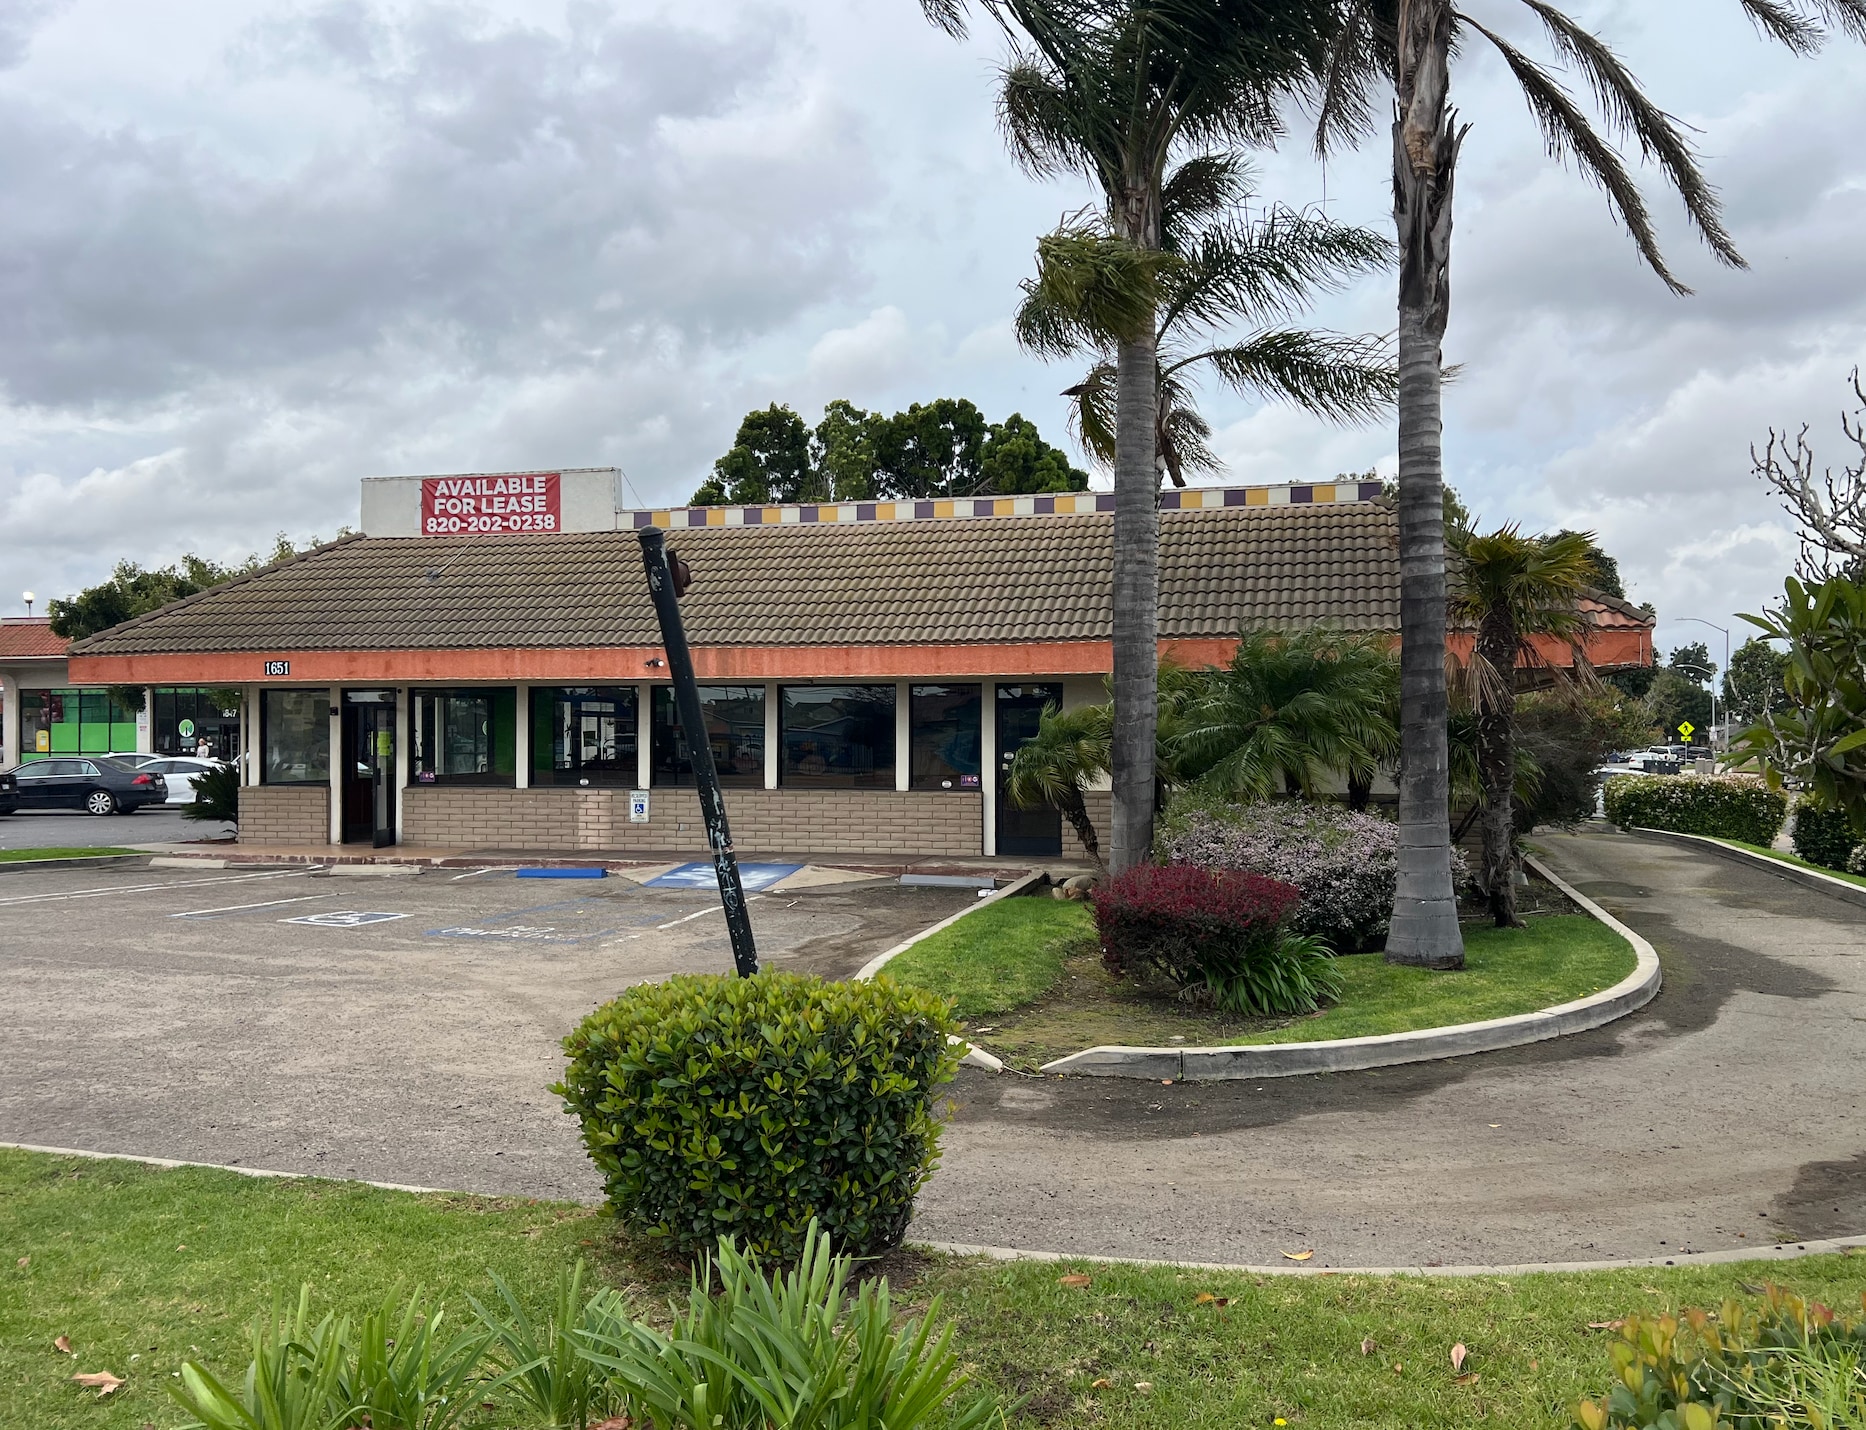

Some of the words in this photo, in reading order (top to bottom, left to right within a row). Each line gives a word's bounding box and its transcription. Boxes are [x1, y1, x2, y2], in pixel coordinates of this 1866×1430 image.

[435, 477, 546, 496] AVAILABLE
[434, 498, 476, 514] FOR
[481, 495, 547, 514] LEASE
[426, 514, 556, 533] 820-202-0238
[265, 662, 289, 675] 1651
